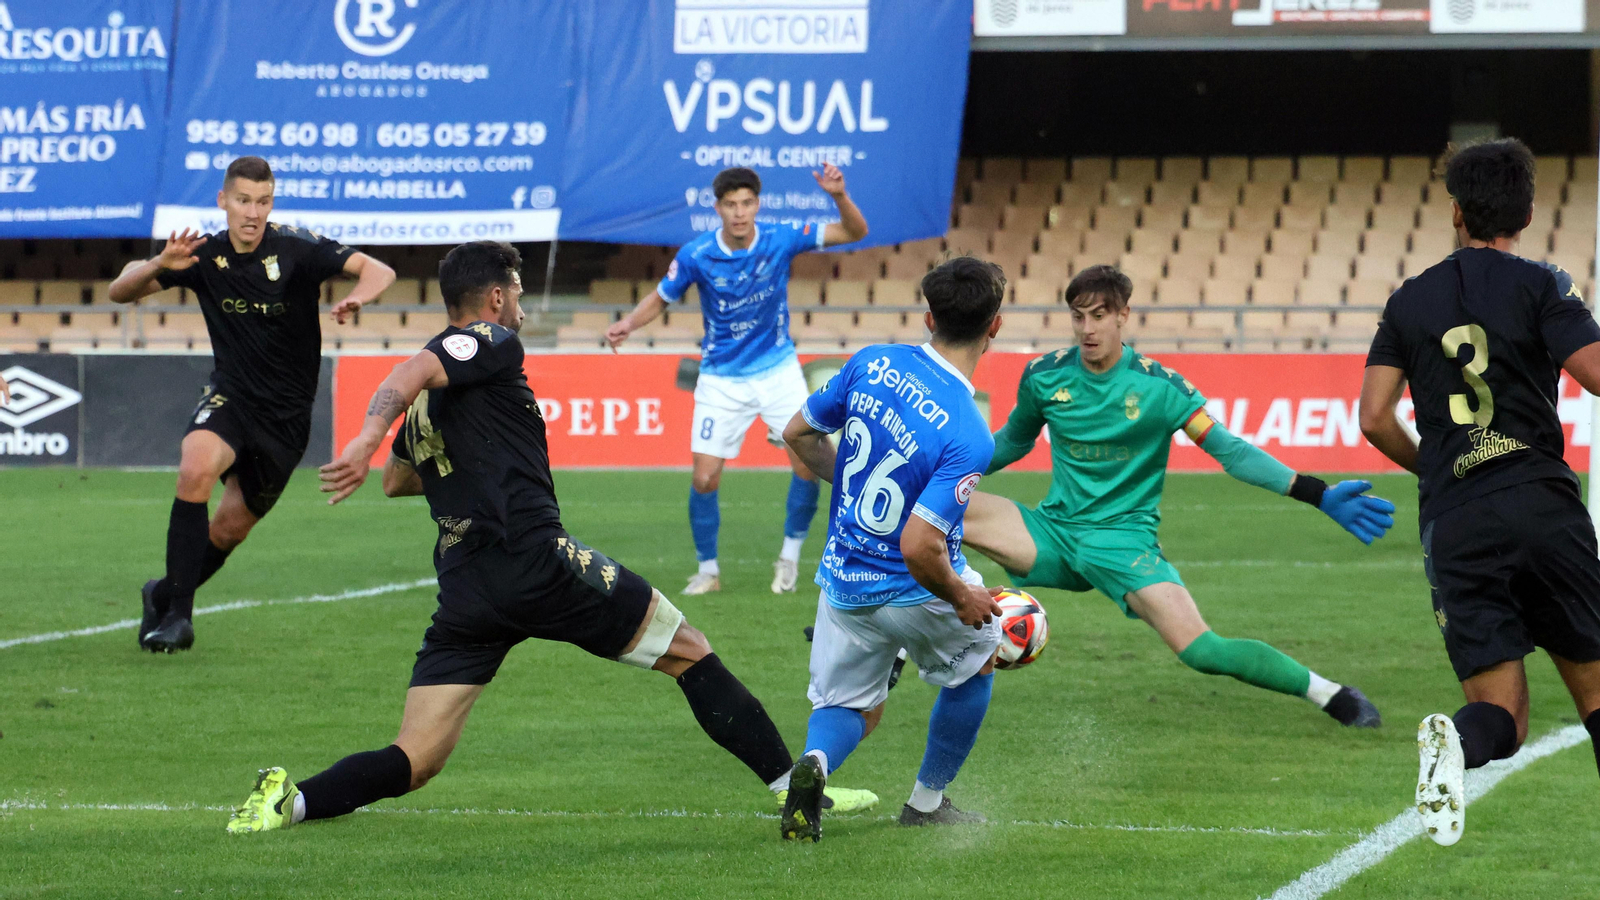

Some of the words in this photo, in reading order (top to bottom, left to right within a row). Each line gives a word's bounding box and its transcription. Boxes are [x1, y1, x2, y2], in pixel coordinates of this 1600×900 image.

[680, 16, 715, 45] LA
[722, 14, 861, 45] VICTORIA
[256, 61, 339, 79] Roberto
[341, 61, 413, 80] Carlos
[416, 61, 490, 83] Ortega
[74, 98, 147, 132] FRÍA
[186, 119, 239, 145] 956
[241, 121, 277, 146] 32
[280, 121, 318, 147] 60
[322, 122, 358, 147] 98
[376, 122, 430, 147] 605
[434, 122, 471, 147] 05
[474, 122, 509, 147] 27
[511, 121, 547, 146] 39
[2, 135, 117, 163] PRECIO
[695, 145, 775, 167] OPTICAL
[777, 145, 853, 167] CENTER
[212, 152, 533, 177] dacho@abogadosrco.com
[273, 178, 330, 199] EREZ
[344, 179, 467, 199] MARBELLA
[904, 371, 932, 396] clínicas
[1441, 323, 1495, 428] 3
[867, 356, 950, 430] Beiman
[543, 398, 664, 436] PEPE
[701, 417, 715, 440] 8
[850, 391, 883, 420] PEPE
[880, 407, 919, 460] RINCÓN
[842, 416, 909, 536] 26
